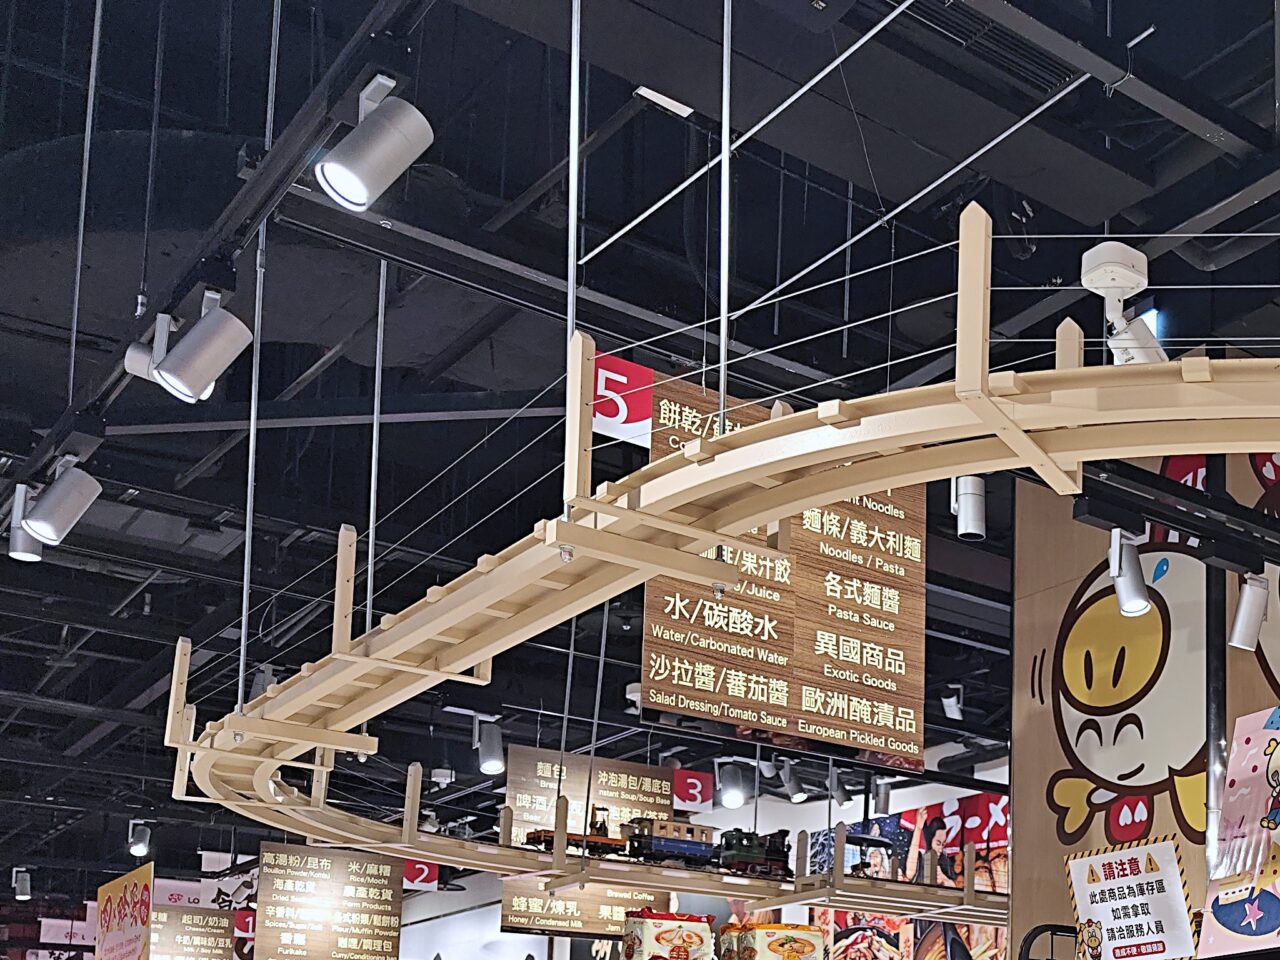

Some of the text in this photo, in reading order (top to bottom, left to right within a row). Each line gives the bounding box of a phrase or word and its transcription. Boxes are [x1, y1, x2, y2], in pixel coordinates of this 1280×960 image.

[594, 368, 628, 424] 5
[863, 496, 905, 519] Noodles
[819, 543, 905, 576] Noodles Pasta
[824, 572, 900, 616] 各式麵醬
[664, 593, 779, 641] 水/碳酸水
[828, 605, 895, 632] Pasta Sauce
[651, 625, 789, 666] Water/Carbonated Water
[814, 630, 906, 675] 異國商品
[824, 665, 897, 691] Exotic Goods
[649, 689, 787, 728] Salad Dressing/Tomato Sauce
[802, 685, 917, 734] 歐洲醃漬品
[798, 720, 919, 755] European Pickled Goods
[686, 778, 702, 804] 3
[413, 865, 429, 883] 2
[1102, 857, 1141, 881] 請注意
[633, 892, 654, 901] Coffee
[1089, 879, 1166, 905] 此處商品為庫存區
[509, 916, 528, 925] Honey
[570, 920, 583, 928] Milk
[1111, 903, 1151, 921] 如需拿取
[1106, 921, 1165, 942] 請洽服務人員
